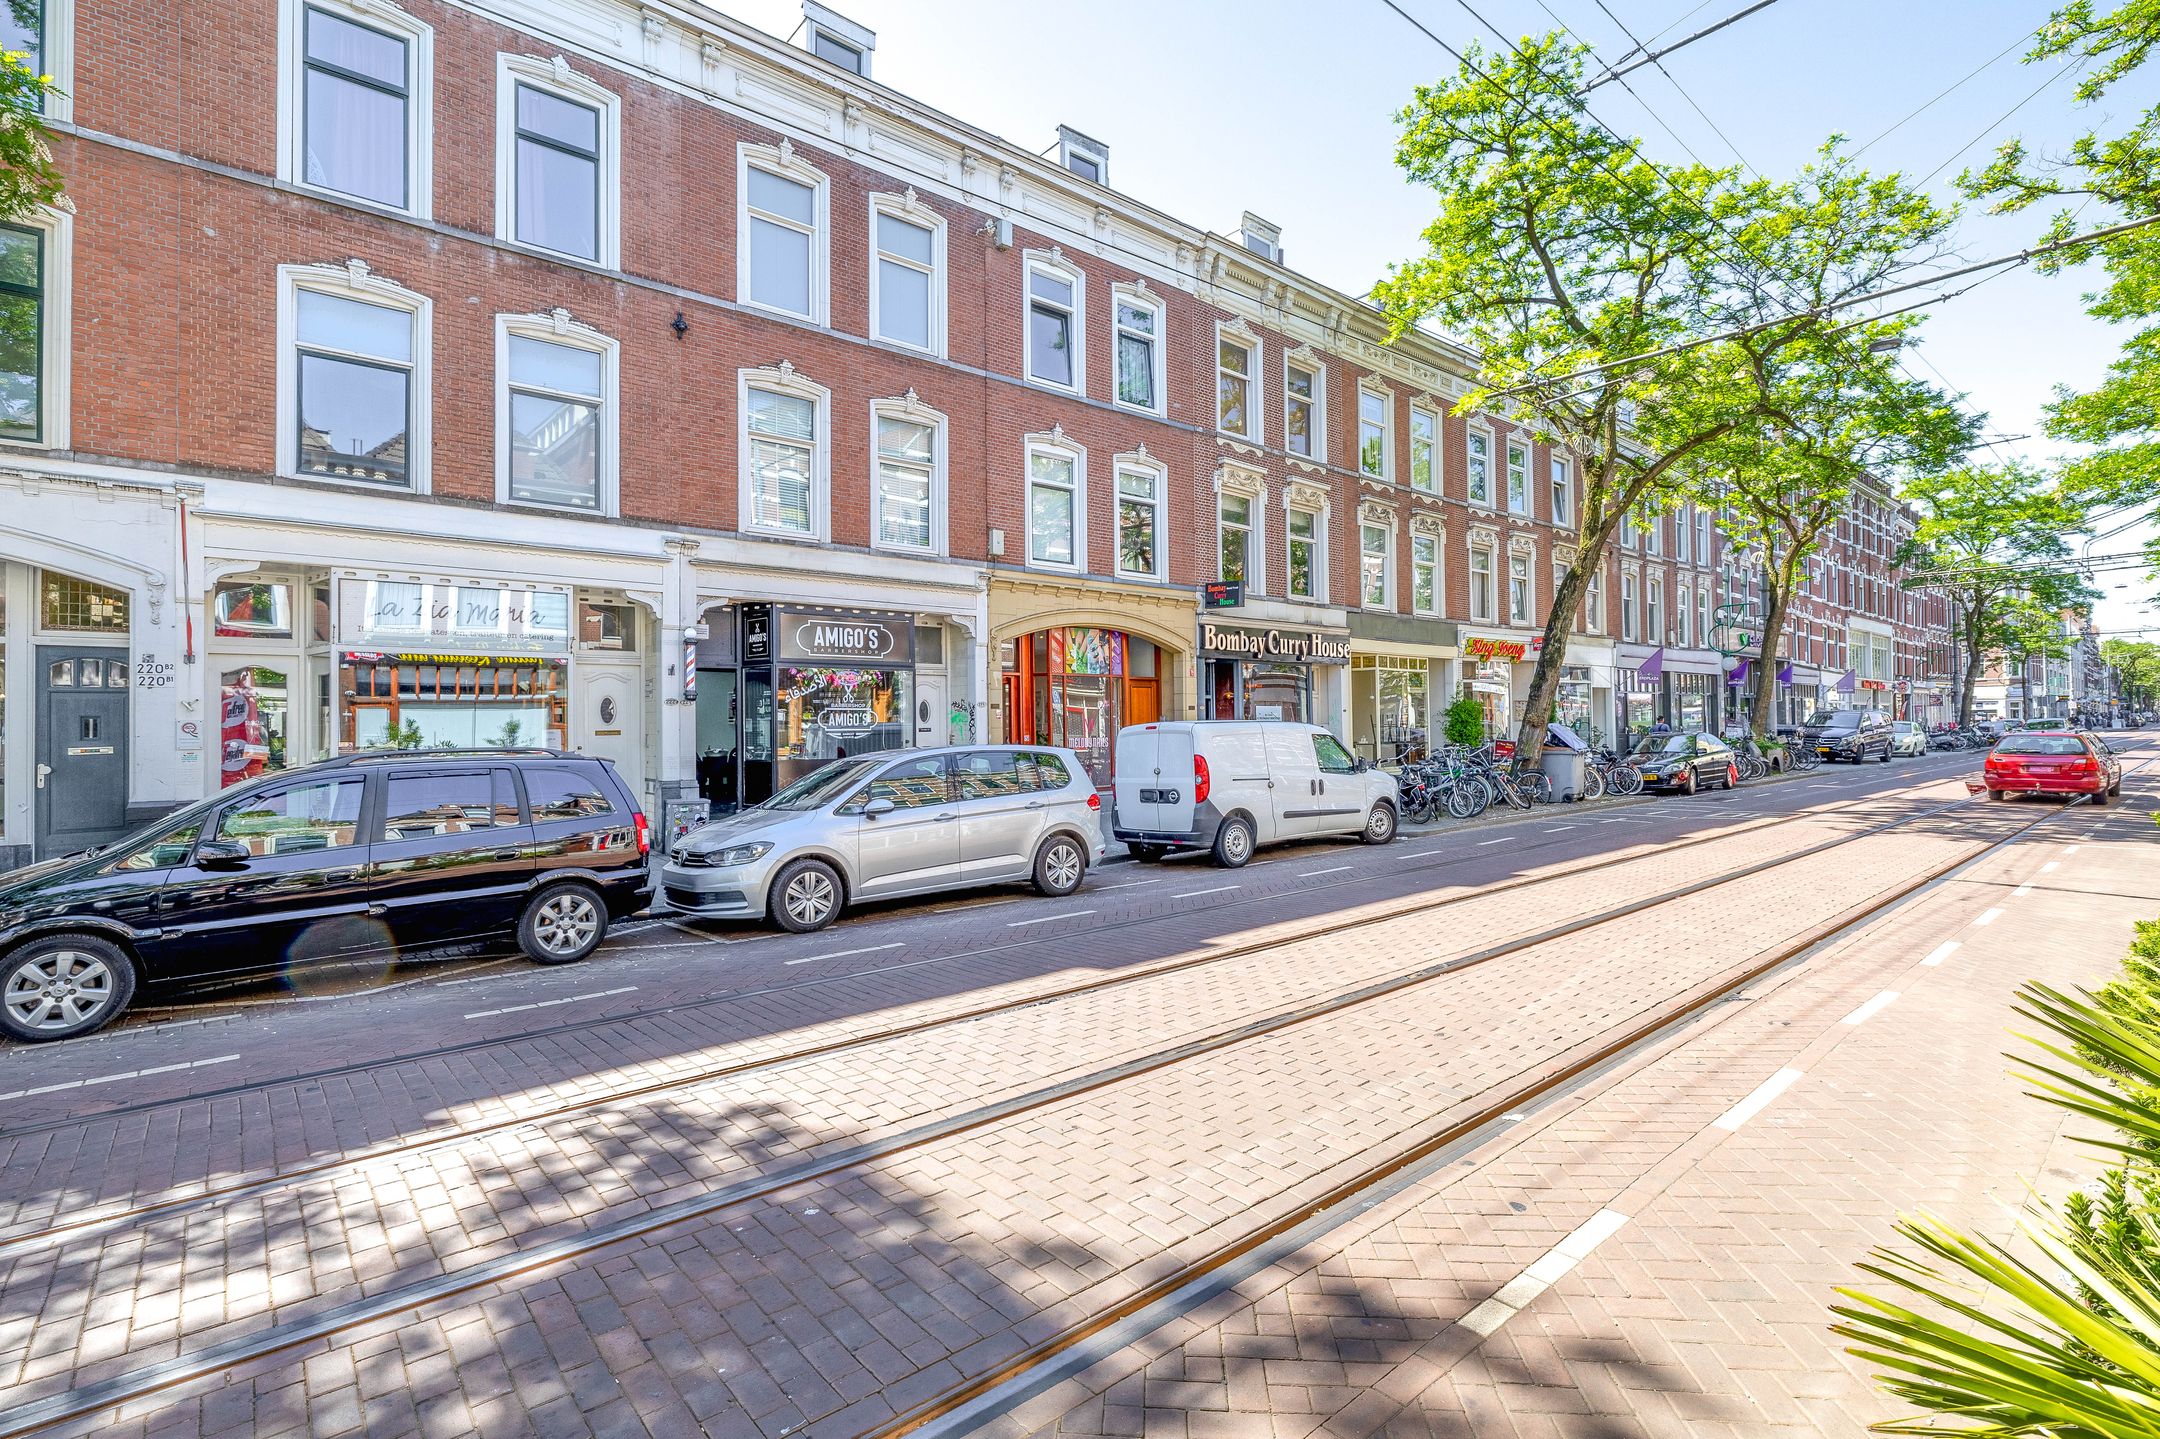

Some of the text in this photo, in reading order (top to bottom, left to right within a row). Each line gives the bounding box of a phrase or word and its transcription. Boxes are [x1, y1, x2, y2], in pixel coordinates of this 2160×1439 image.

[1208, 585, 1227, 593] Bombay
[814, 626, 879, 649] AMIGO'S
[1204, 625, 1351, 661] Bombay Curry House
[829, 713, 869, 726] AMIGO'S
